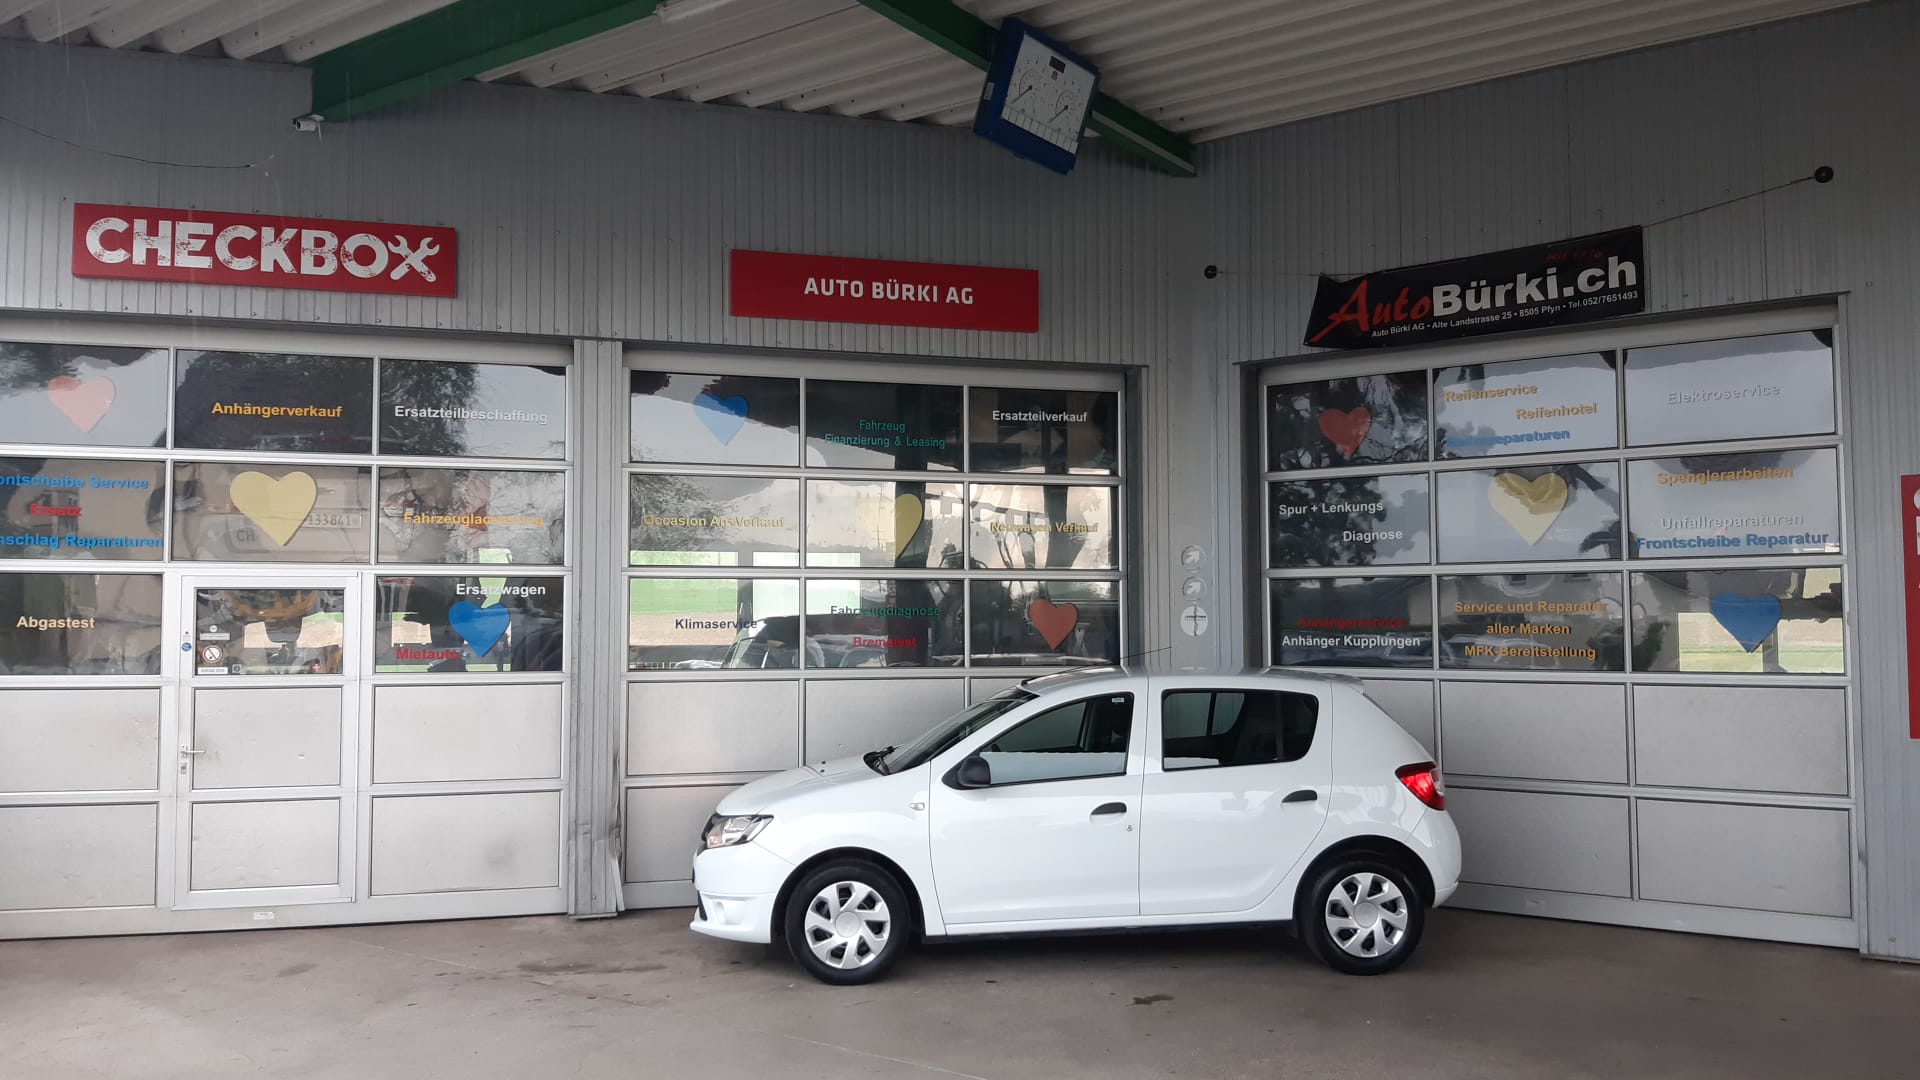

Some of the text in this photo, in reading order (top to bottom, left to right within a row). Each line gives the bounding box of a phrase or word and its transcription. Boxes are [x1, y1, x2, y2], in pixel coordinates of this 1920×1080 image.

[804, 278, 973, 305] AUTO BÜRKI AG
[1391, 325, 1410, 335] Bürki
[1411, 322, 1425, 331] AG
[1432, 320, 1448, 329] Alte
[1450, 314, 1500, 327] Landstrasse
[1501, 311, 1512, 320] 25
[1519, 308, 1539, 317] 8505
[1541, 304, 1561, 315] Pfyn
[1445, 385, 1538, 402] Reifenservice
[1666, 383, 1781, 404] Elektroservice
[212, 402, 343, 418] Anhängerverkauf
[394, 405, 548, 425] Ersatzteilbeschaffung
[992, 410, 1088, 422] Ersatzteilverkauf
[1516, 403, 1597, 420] Reifenhotel
[859, 419, 906, 433] Fahrzeug
[824, 433, 946, 449] Finanzierung & Leasing
[88, 475, 149, 490] Service
[1657, 466, 1794, 486] Spenglerarbeiten
[31, 503, 82, 517] Ersatz
[1279, 501, 1384, 517] Spur + Lenkungs
[643, 514, 707, 527] Occasion
[1660, 513, 1804, 531] Unfallreparaturen
[65, 534, 164, 549] Reparaturen
[236, 529, 255, 542] CH
[1343, 529, 1403, 543] Diagnose
[1636, 531, 1829, 550] Frontscheibe Reparatur
[456, 583, 546, 598] Ersatzwagen
[830, 605, 942, 618] Fahrzeugdiagnose
[1455, 601, 1504, 613] Service
[1507, 600, 1534, 612] und
[16, 615, 96, 630] Abgastest
[674, 618, 758, 630] Klimaservice
[1486, 623, 1572, 635] aller Marken
[1281, 634, 1421, 649] Anhänger Kupplungen
